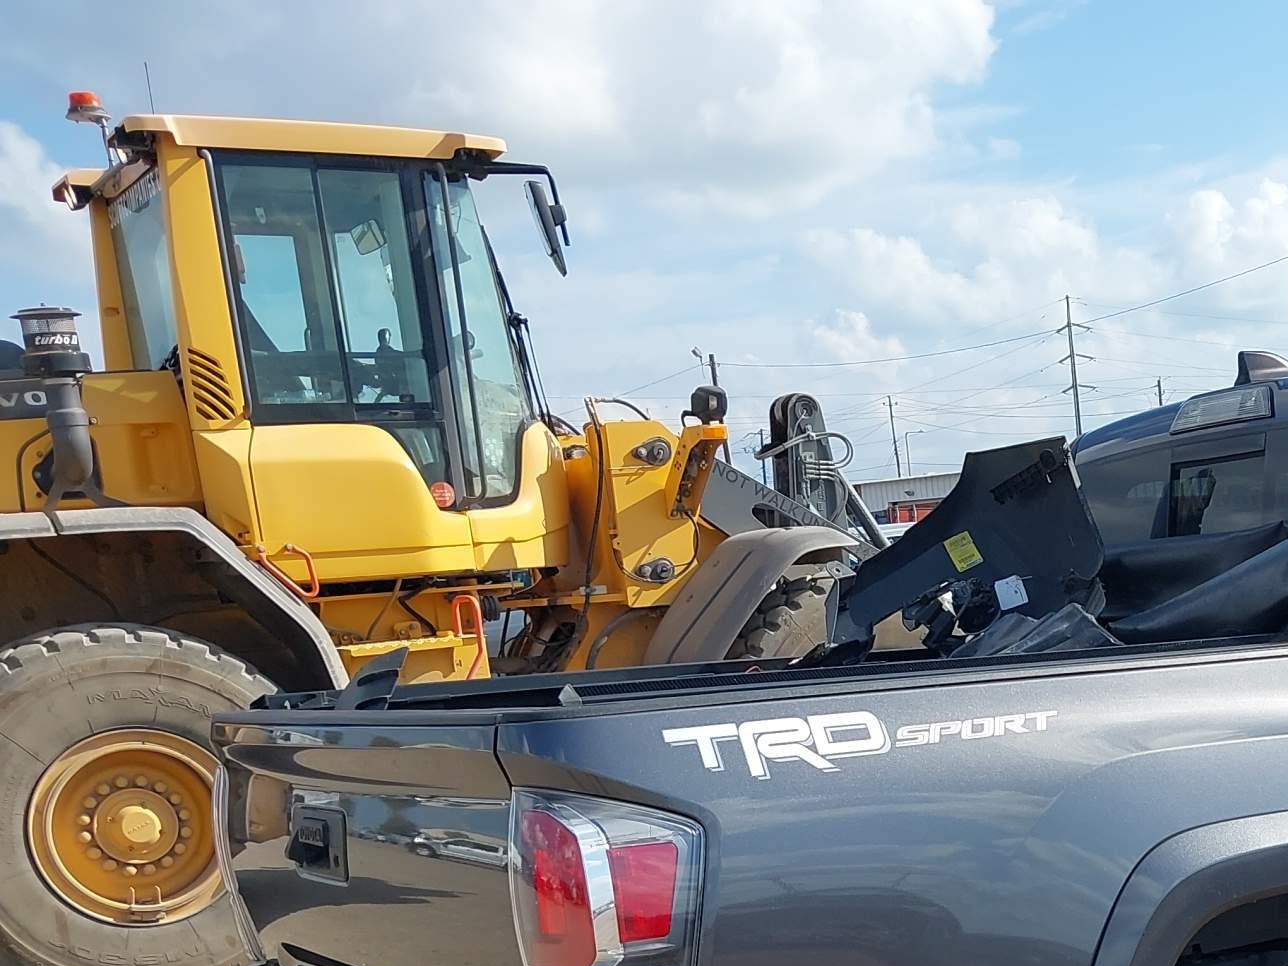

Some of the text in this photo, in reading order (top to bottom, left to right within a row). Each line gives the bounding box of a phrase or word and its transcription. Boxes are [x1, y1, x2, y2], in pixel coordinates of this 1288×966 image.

[713, 461, 750, 489] NOT
[754, 487, 798, 518] WALK
[662, 710, 1058, 780] TRD SPORT
